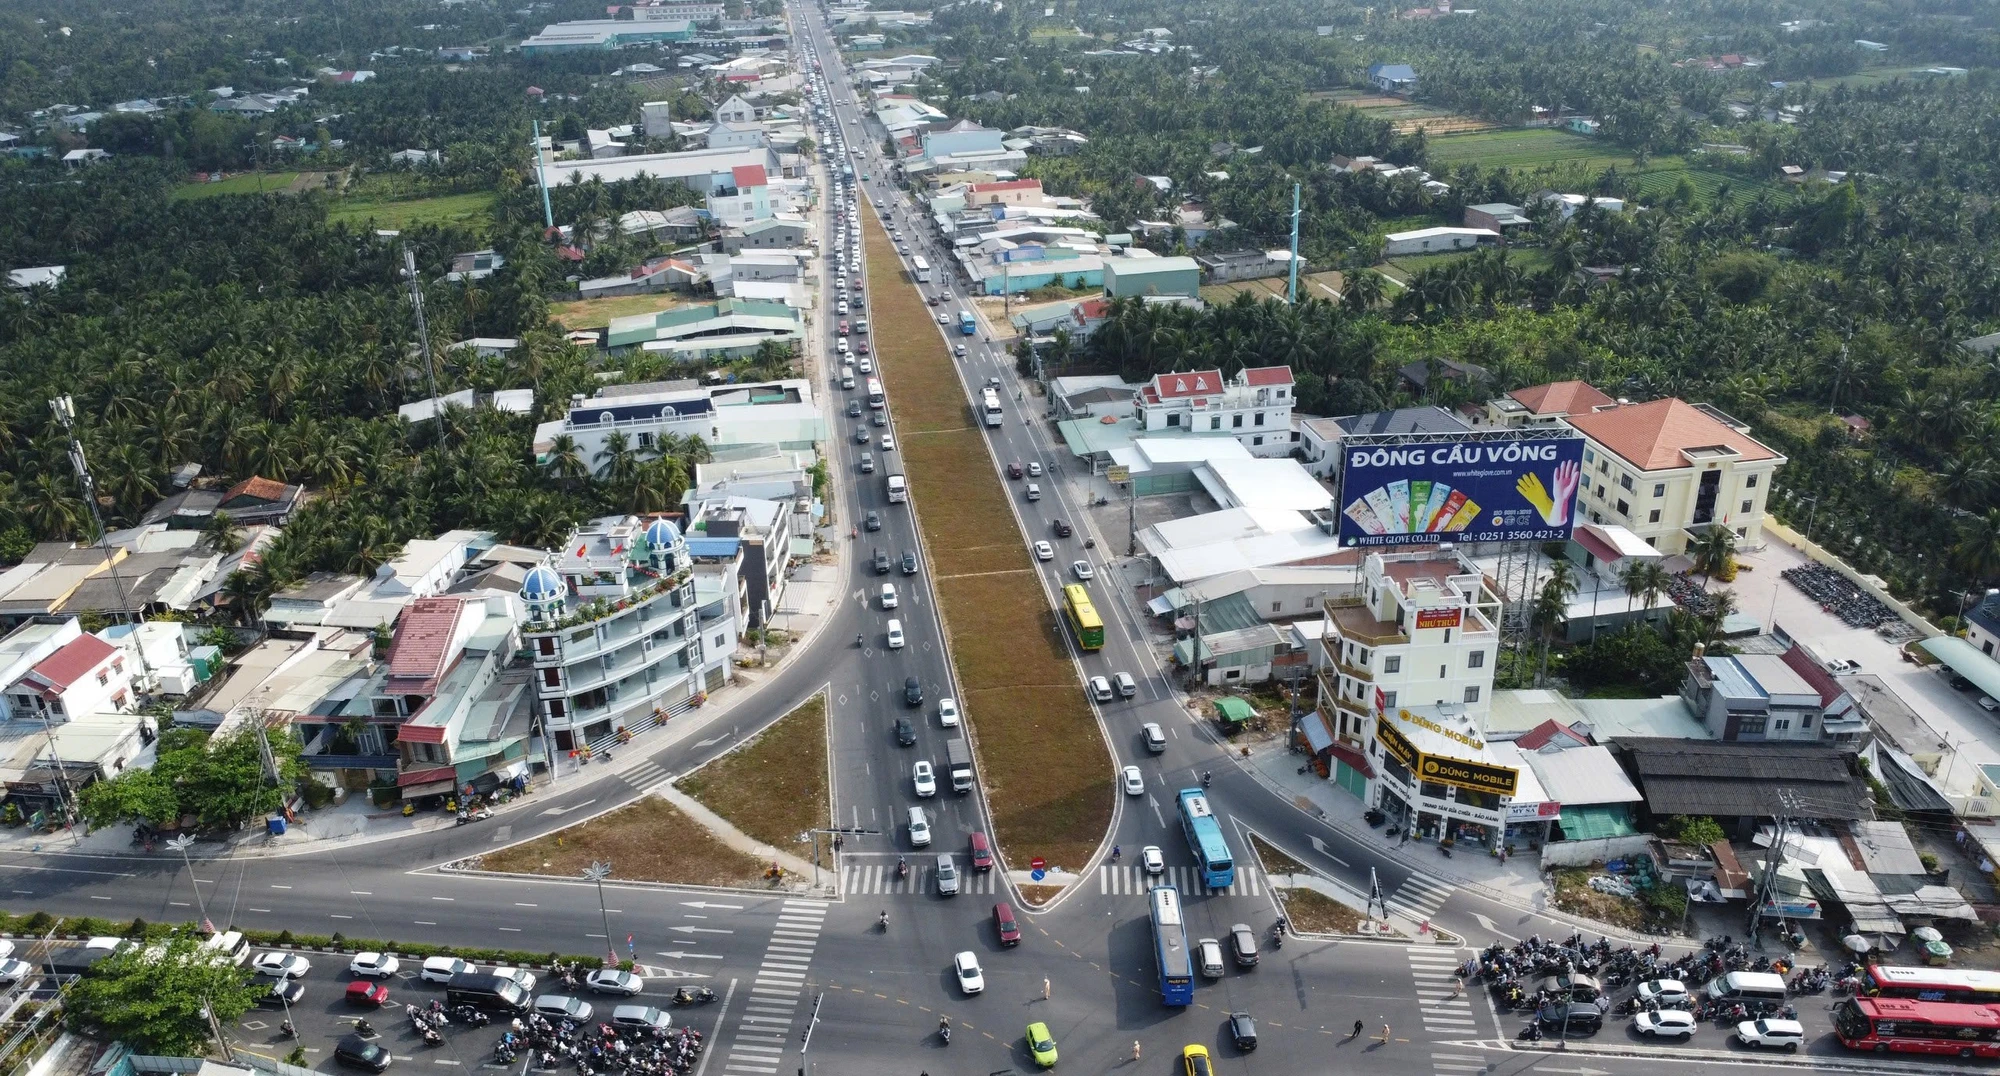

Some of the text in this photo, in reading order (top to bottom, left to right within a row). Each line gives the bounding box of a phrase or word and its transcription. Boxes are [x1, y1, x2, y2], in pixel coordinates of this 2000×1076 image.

[1351, 441, 1557, 467] ĐÔNG CẦU VỒNG
[1359, 537, 1384, 545] WHITE
[1386, 535, 1410, 544] GLOVE
[1458, 533, 1472, 541] Tel
[1479, 531, 1504, 541] 0251
[1507, 530, 1533, 540] 3560
[1534, 529, 1564, 539] 421-2
[1444, 728, 1484, 751] MOBILE
[1440, 766, 1470, 778] DŨNG
[1473, 772, 1513, 786] MOBILE
